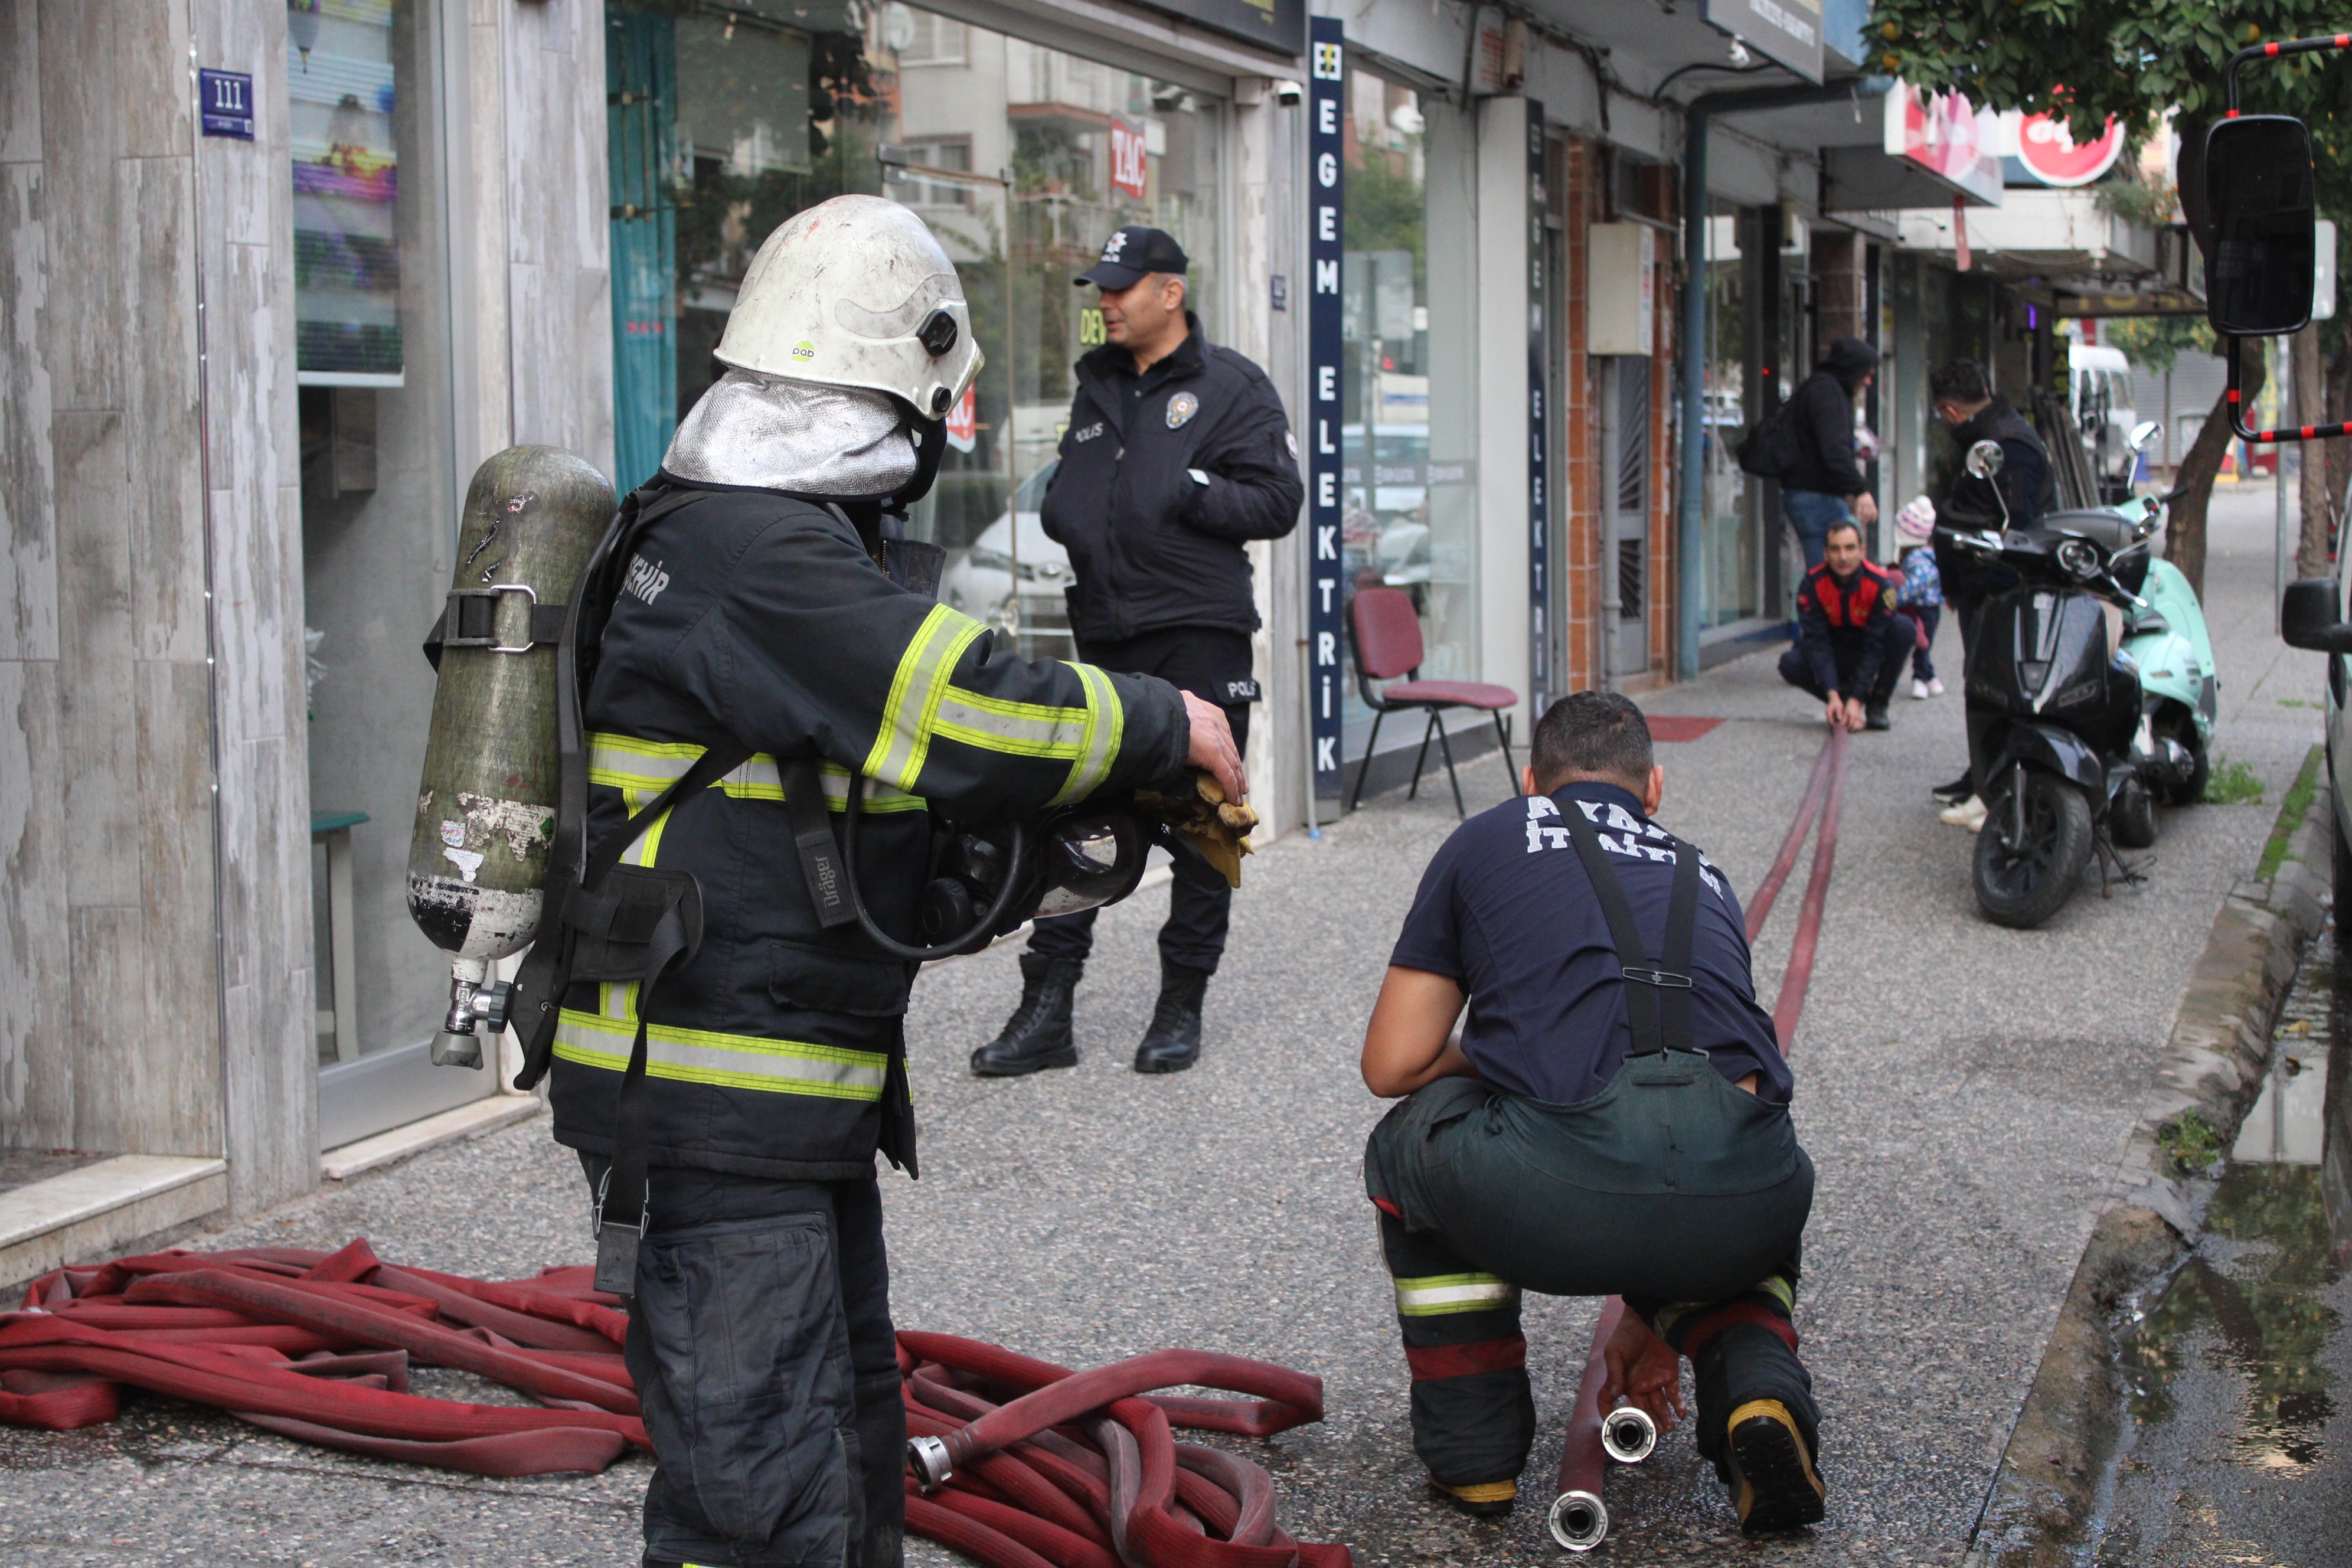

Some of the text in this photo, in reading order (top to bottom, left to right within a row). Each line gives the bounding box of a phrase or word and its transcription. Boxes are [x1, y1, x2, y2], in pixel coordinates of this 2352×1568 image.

[215, 79, 243, 110] 111
[1112, 129, 1145, 197] TAÇ
[792, 347, 815, 358] pab
[1317, 99, 1338, 772] EGEM ELEKTRİK
[815, 855, 840, 909] Dräger
